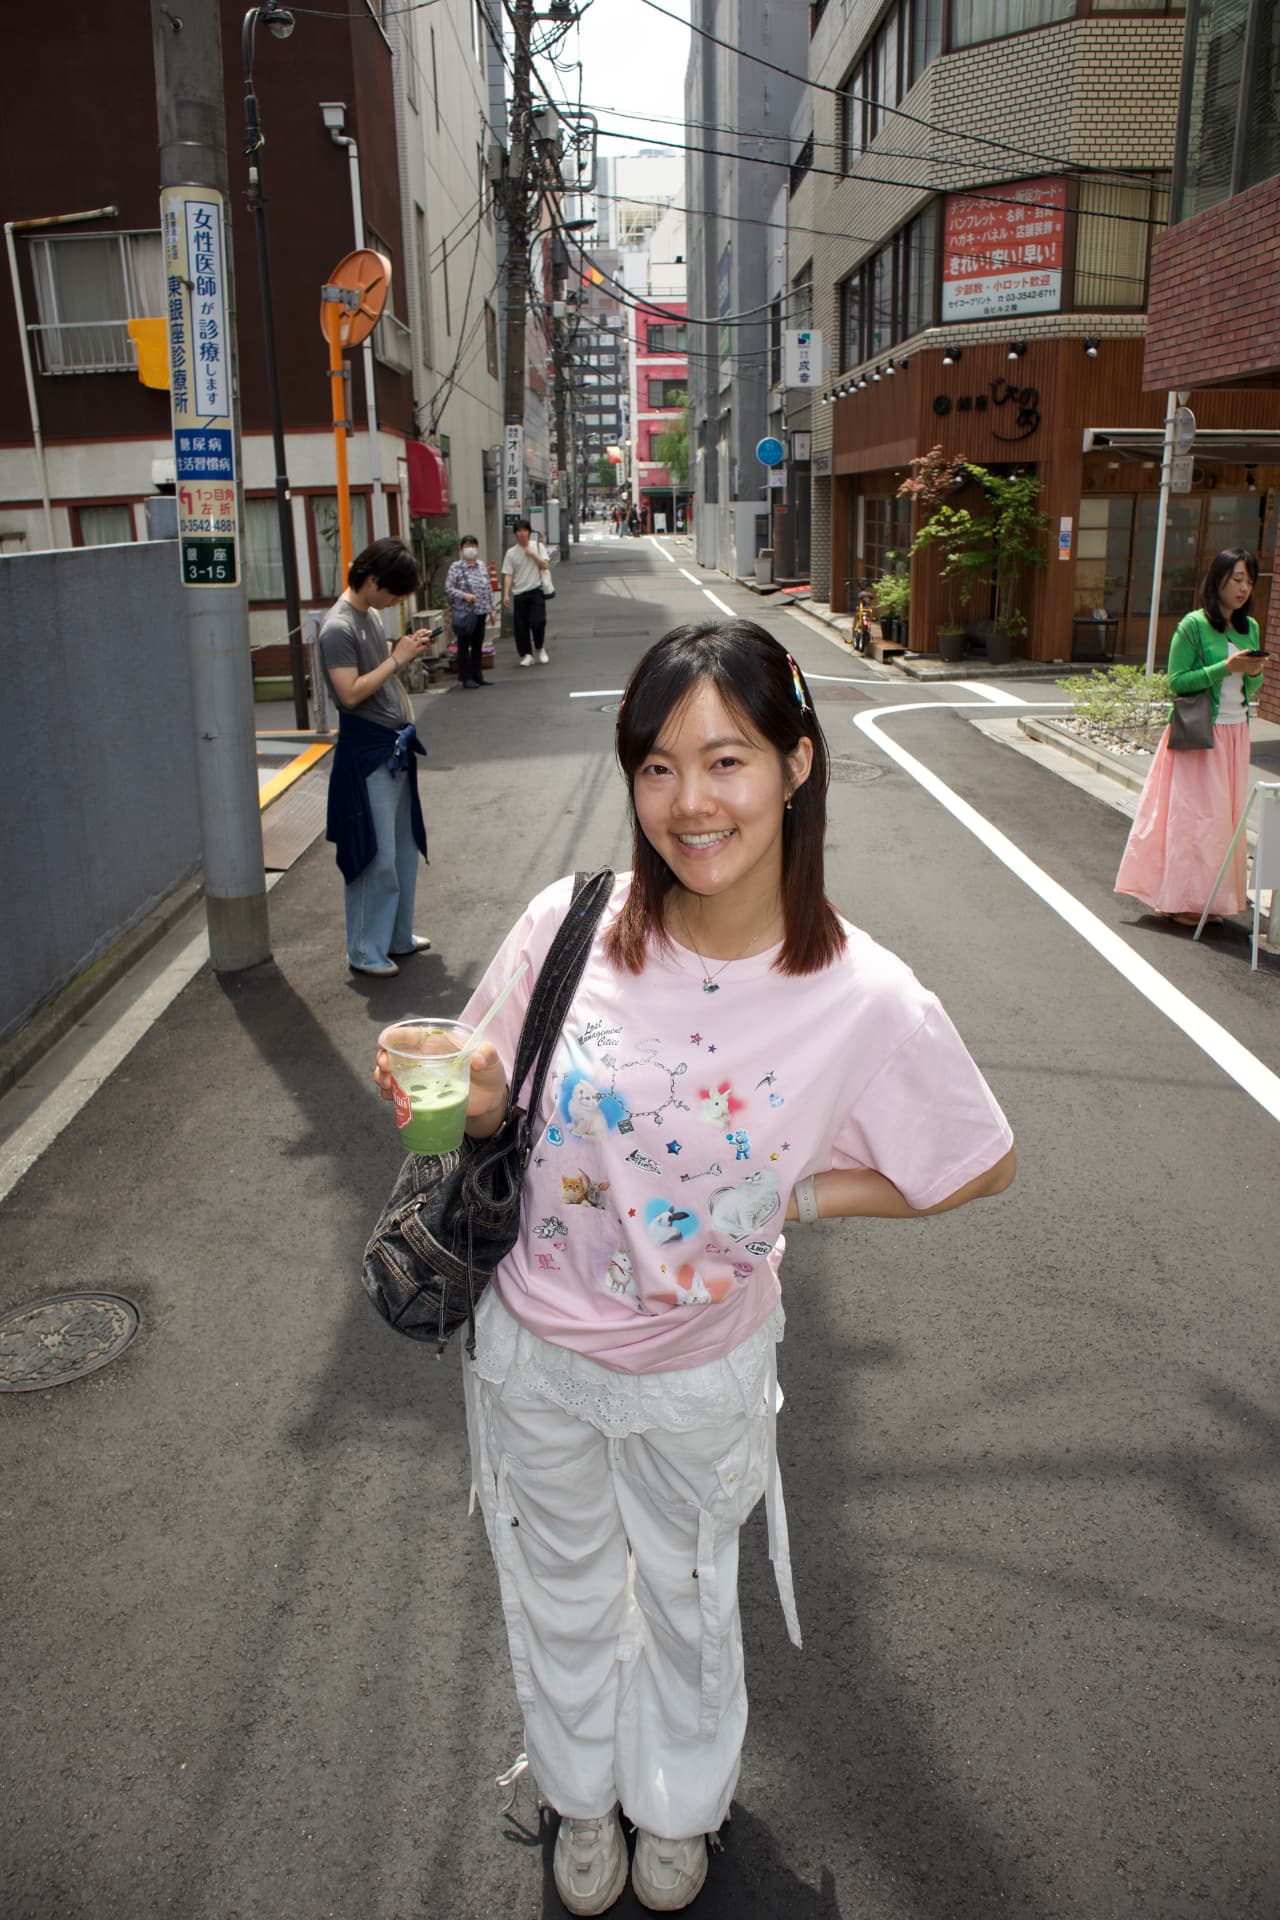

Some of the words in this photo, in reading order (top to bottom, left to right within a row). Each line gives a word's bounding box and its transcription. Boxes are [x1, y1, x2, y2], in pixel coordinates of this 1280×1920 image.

[192, 208, 220, 405] 女性医師が診療します
[168, 274, 189, 414] 東銀座診療所
[180, 437, 222, 451] 糖尿病
[177, 456, 231, 472] 生活習慣病
[189, 565, 227, 579] 3-15
